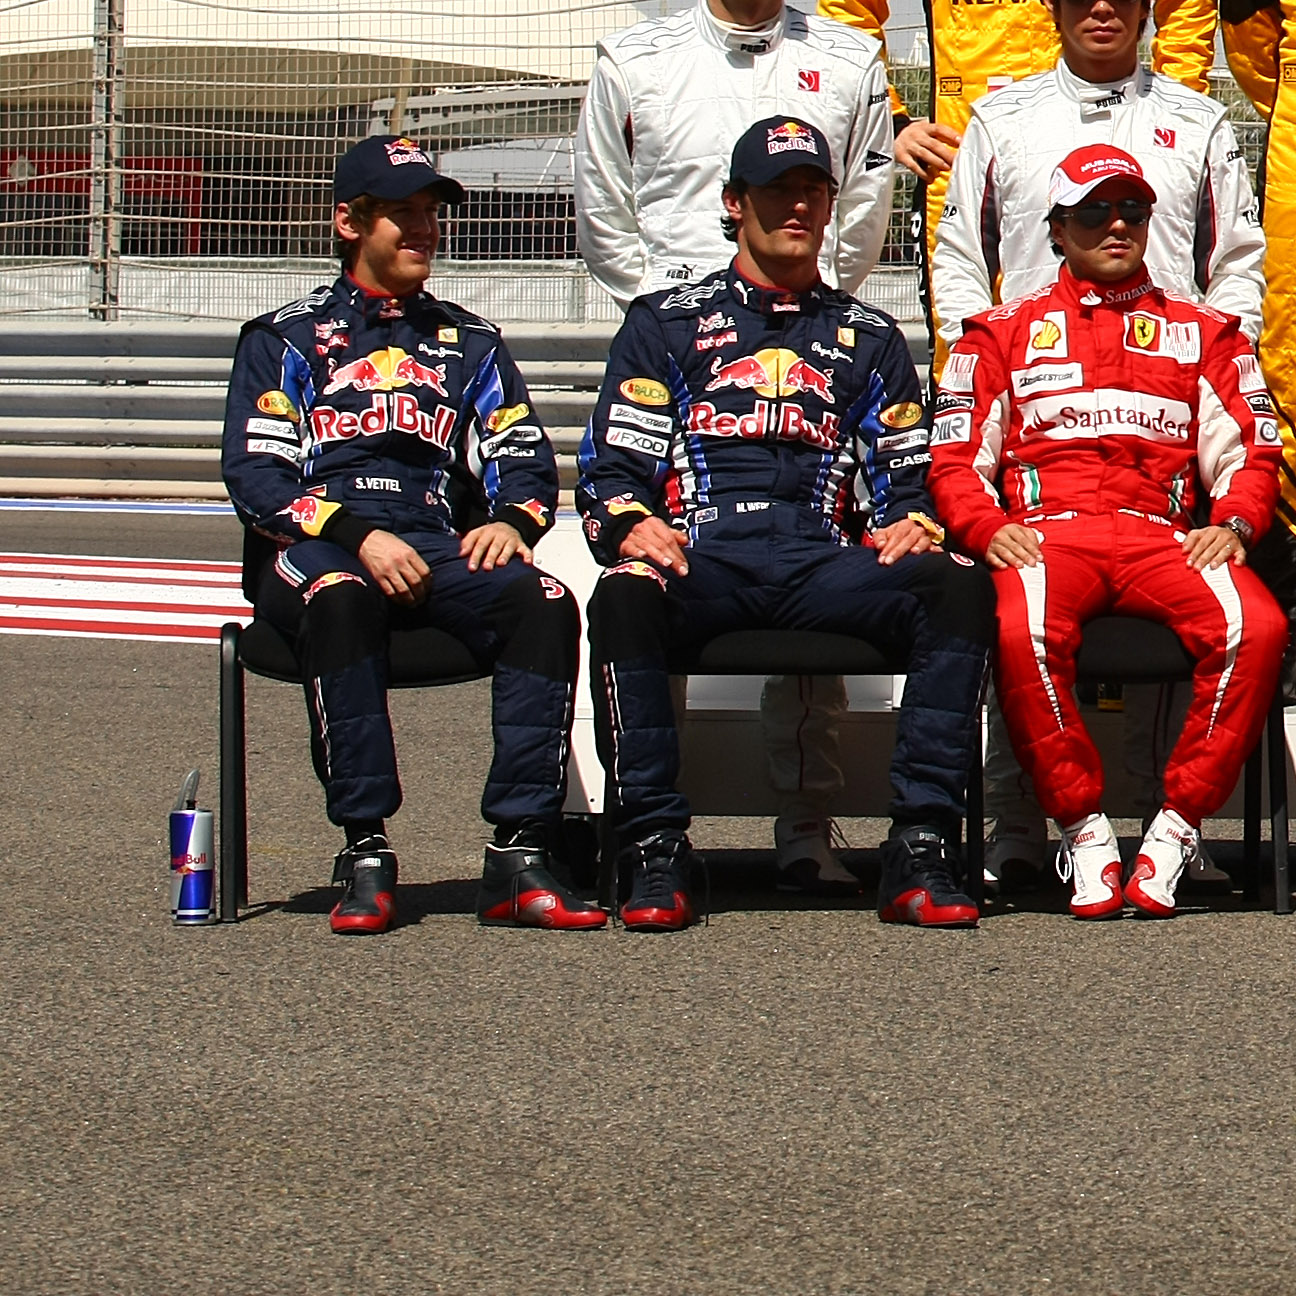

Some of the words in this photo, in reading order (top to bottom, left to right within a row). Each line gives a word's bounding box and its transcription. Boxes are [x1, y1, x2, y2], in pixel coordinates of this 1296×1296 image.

[941, 81, 961, 94] OMP
[1105, 277, 1155, 304] Santand
[635, 384, 667, 401] RAUCH
[311, 394, 388, 445] Red
[392, 392, 457, 451] Bull
[687, 400, 768, 439] Red
[778, 402, 842, 452] Bull
[1060, 407, 1187, 440] Santander
[620, 431, 665, 454] FXDD
[355, 477, 402, 493] S.VETTEL
